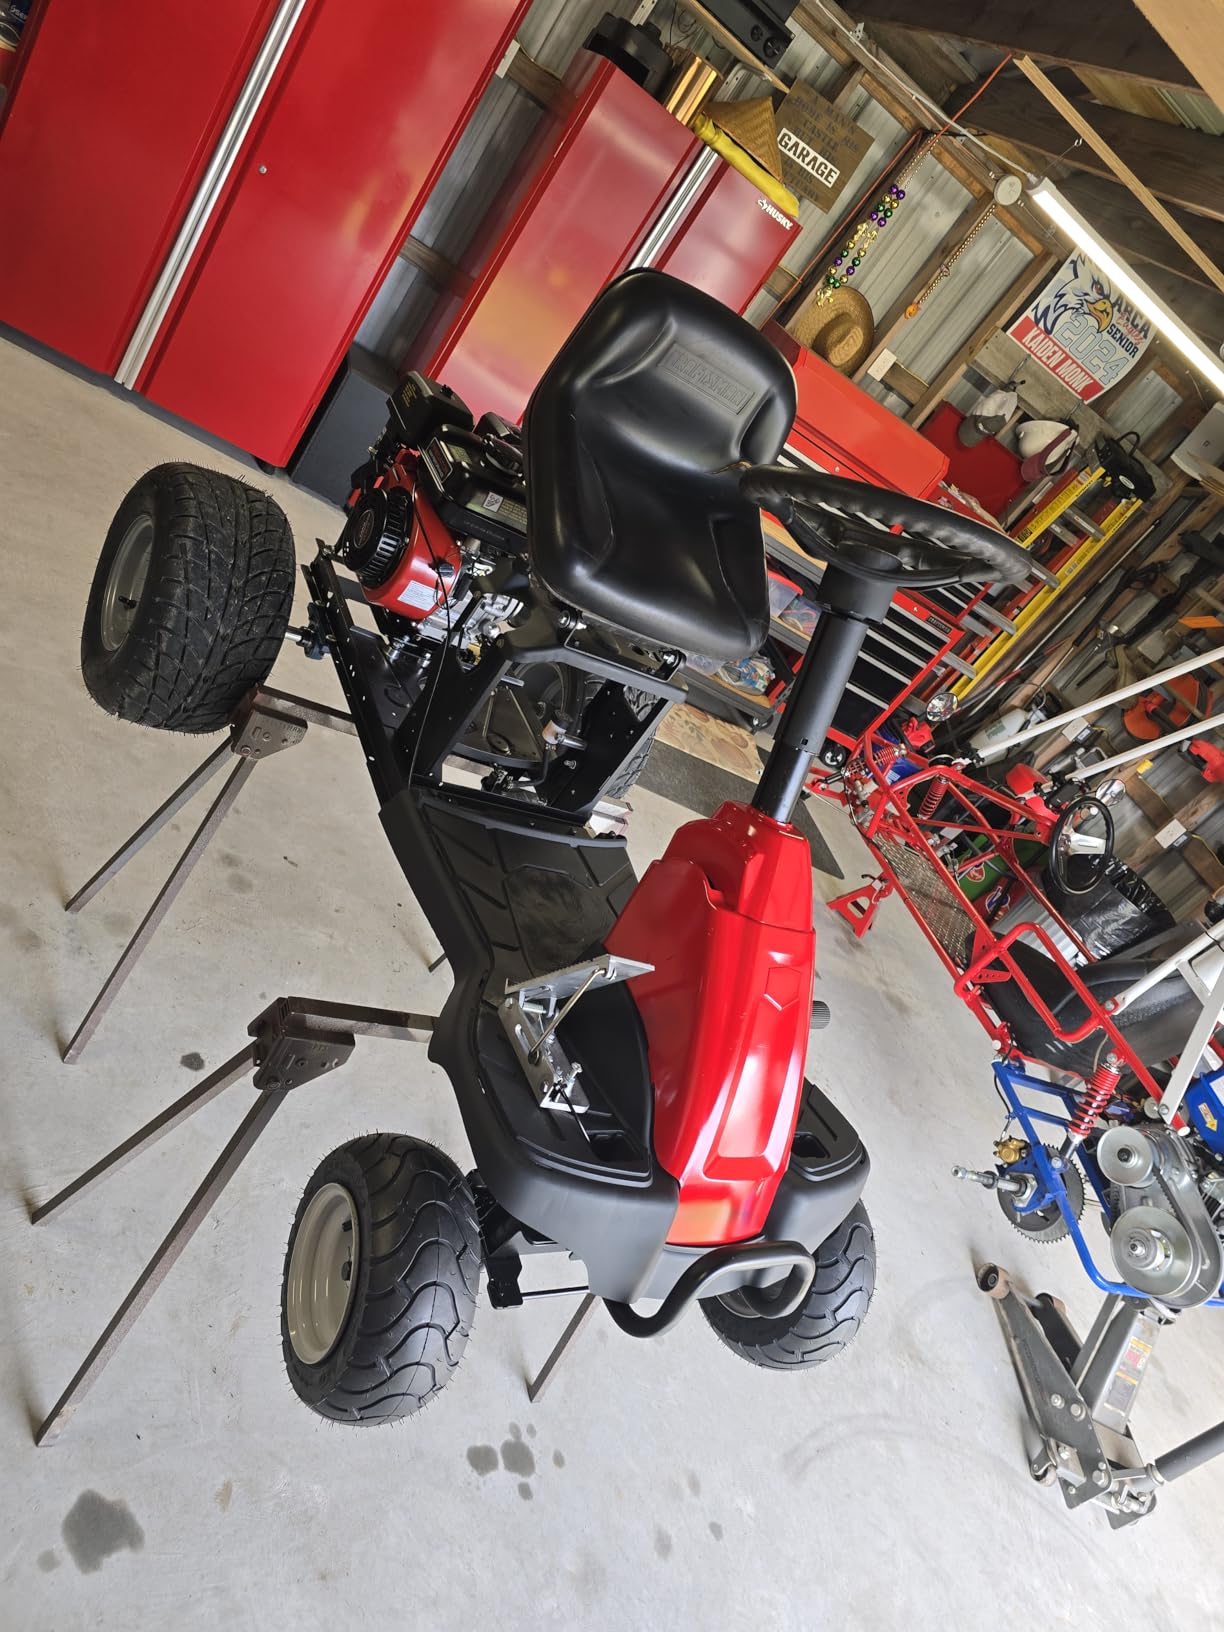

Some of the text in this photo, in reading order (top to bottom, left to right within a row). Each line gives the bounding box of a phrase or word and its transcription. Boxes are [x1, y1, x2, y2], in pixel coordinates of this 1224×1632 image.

[778, 132, 838, 185] GARAGE
[766, 204, 793, 230] HUSKY
[1106, 324, 1140, 359] SENIOR
[1112, 294, 1151, 340] ARCA
[1022, 326, 1094, 393] KAIDEN MONK
[1053, 315, 1130, 386] 2024
